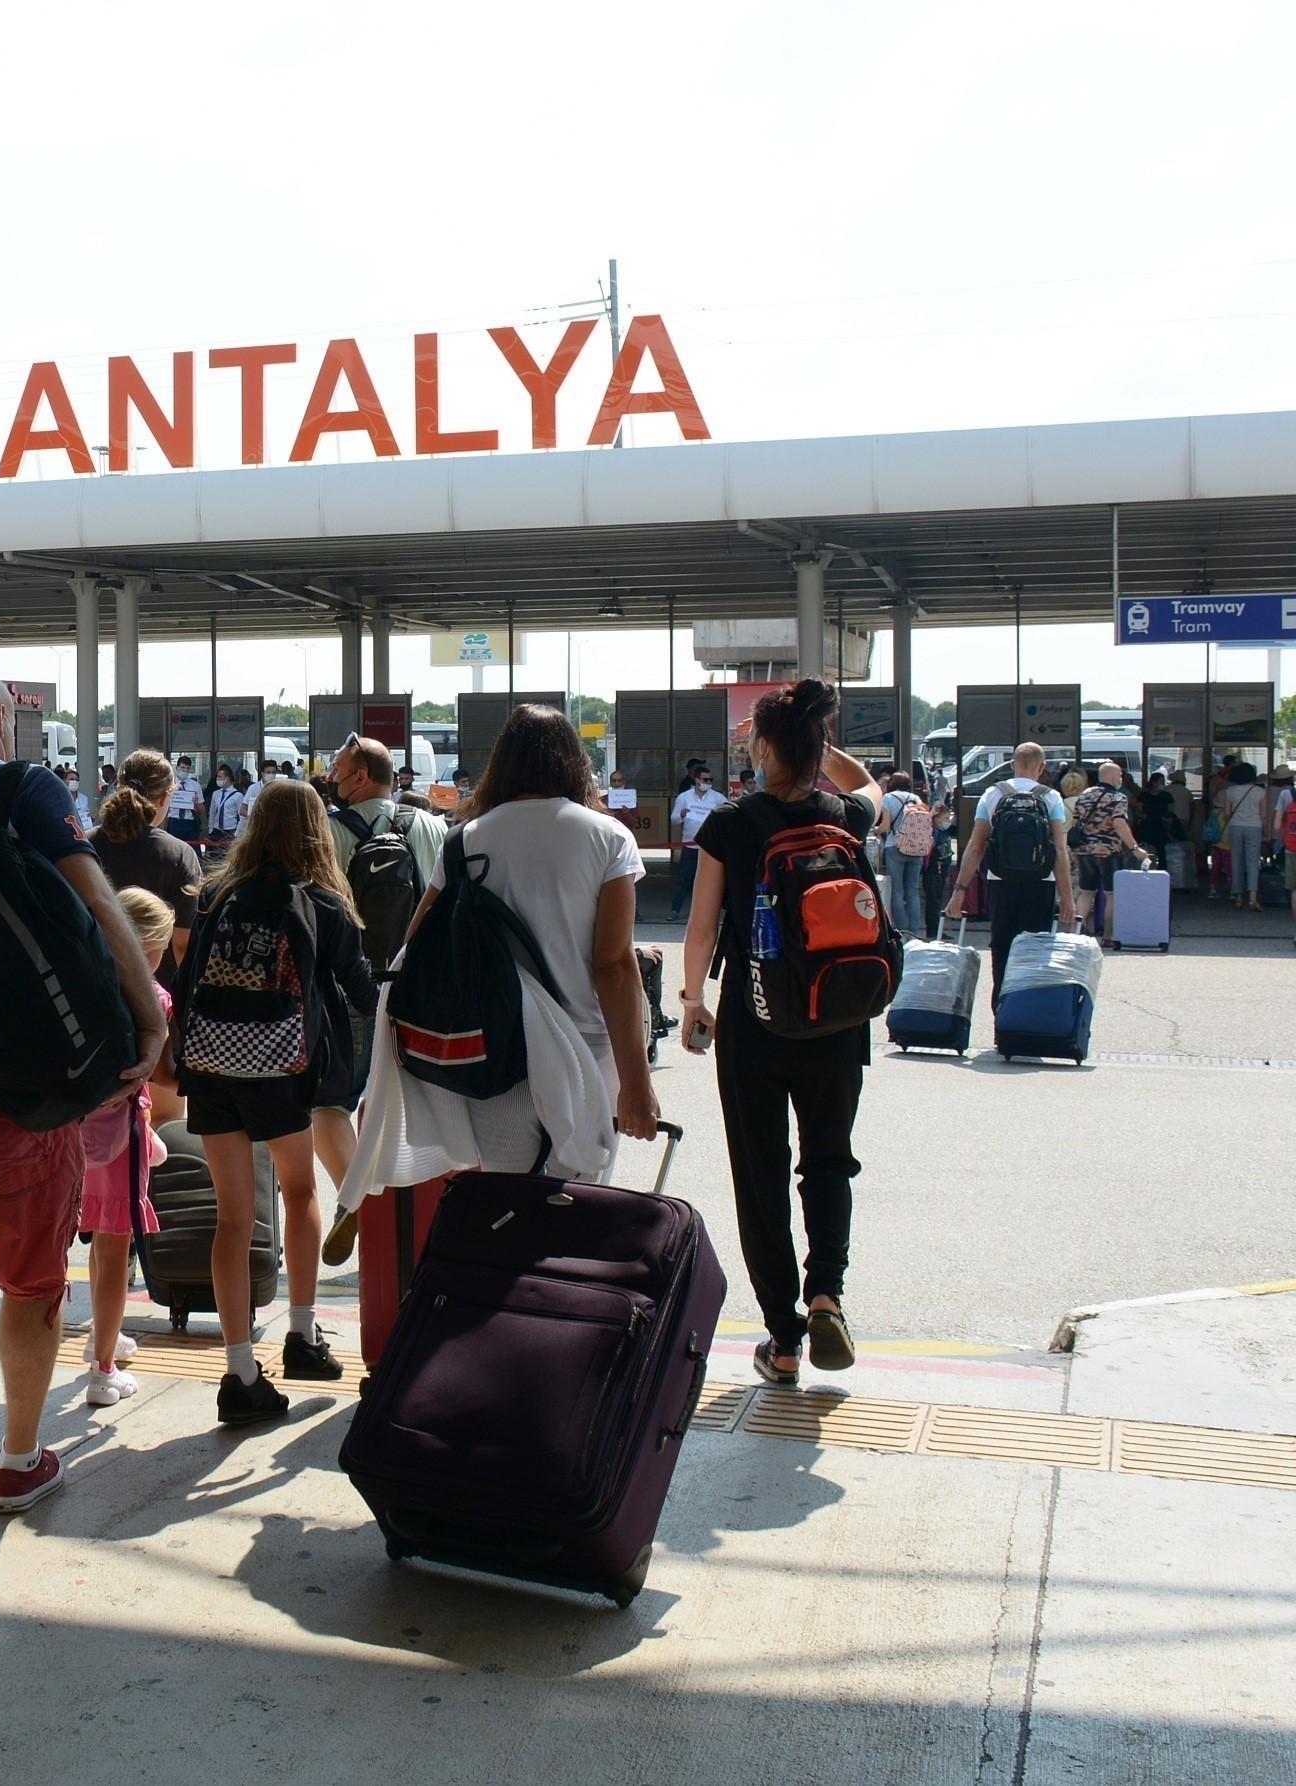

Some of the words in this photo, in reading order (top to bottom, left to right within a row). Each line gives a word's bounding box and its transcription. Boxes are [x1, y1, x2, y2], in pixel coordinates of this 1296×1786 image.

[1171, 601, 1246, 616] Tramvay
[1171, 619, 1211, 633] Tram
[750, 960, 772, 1021] ROSSI
